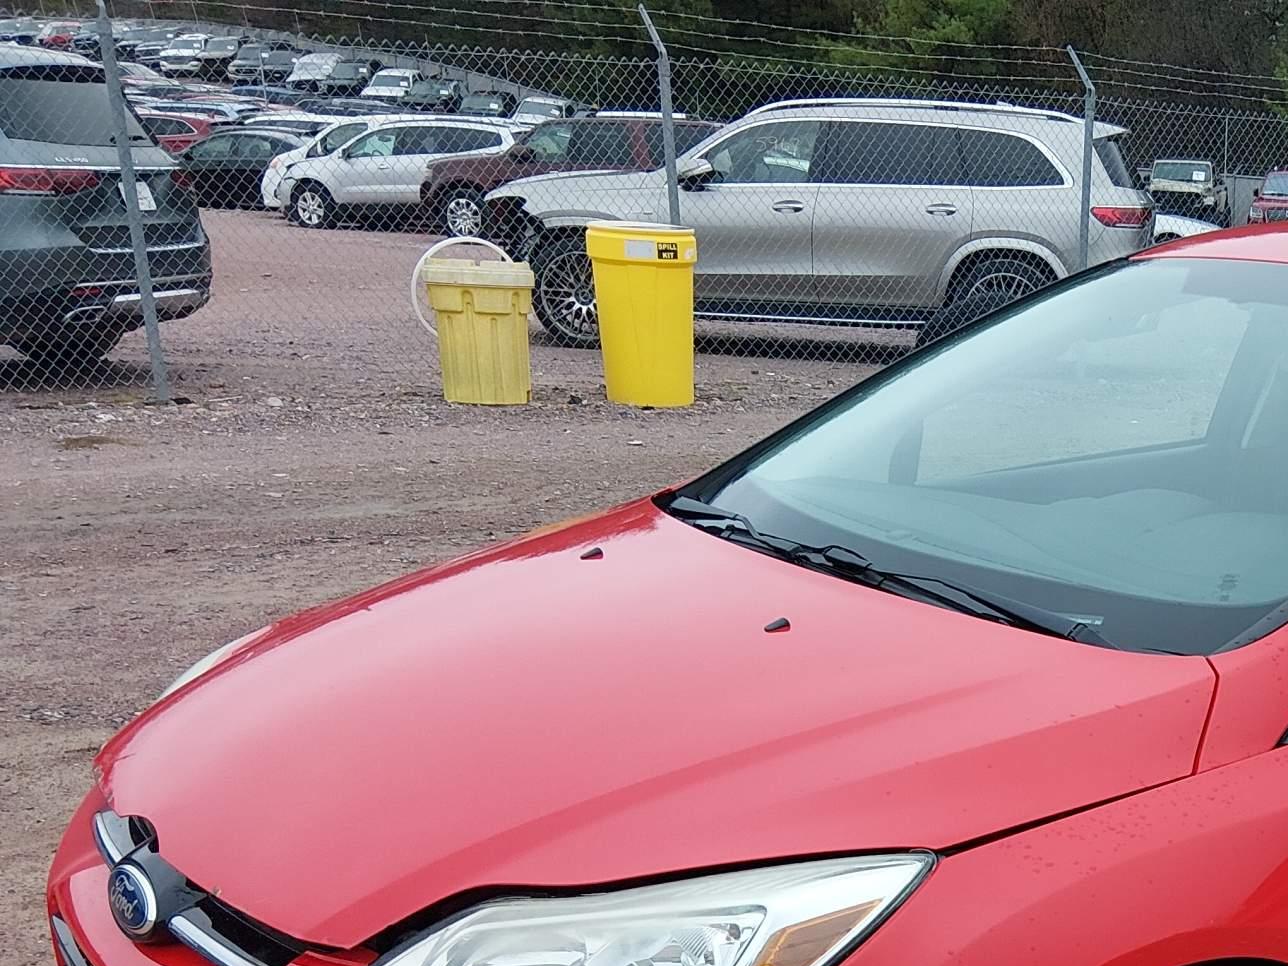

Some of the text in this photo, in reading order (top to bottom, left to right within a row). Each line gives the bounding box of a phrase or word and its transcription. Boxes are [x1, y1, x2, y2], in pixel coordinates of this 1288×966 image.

[658, 243, 677, 251] SPILL
[661, 251, 675, 259] KIT
[110, 874, 138, 920] Ford
